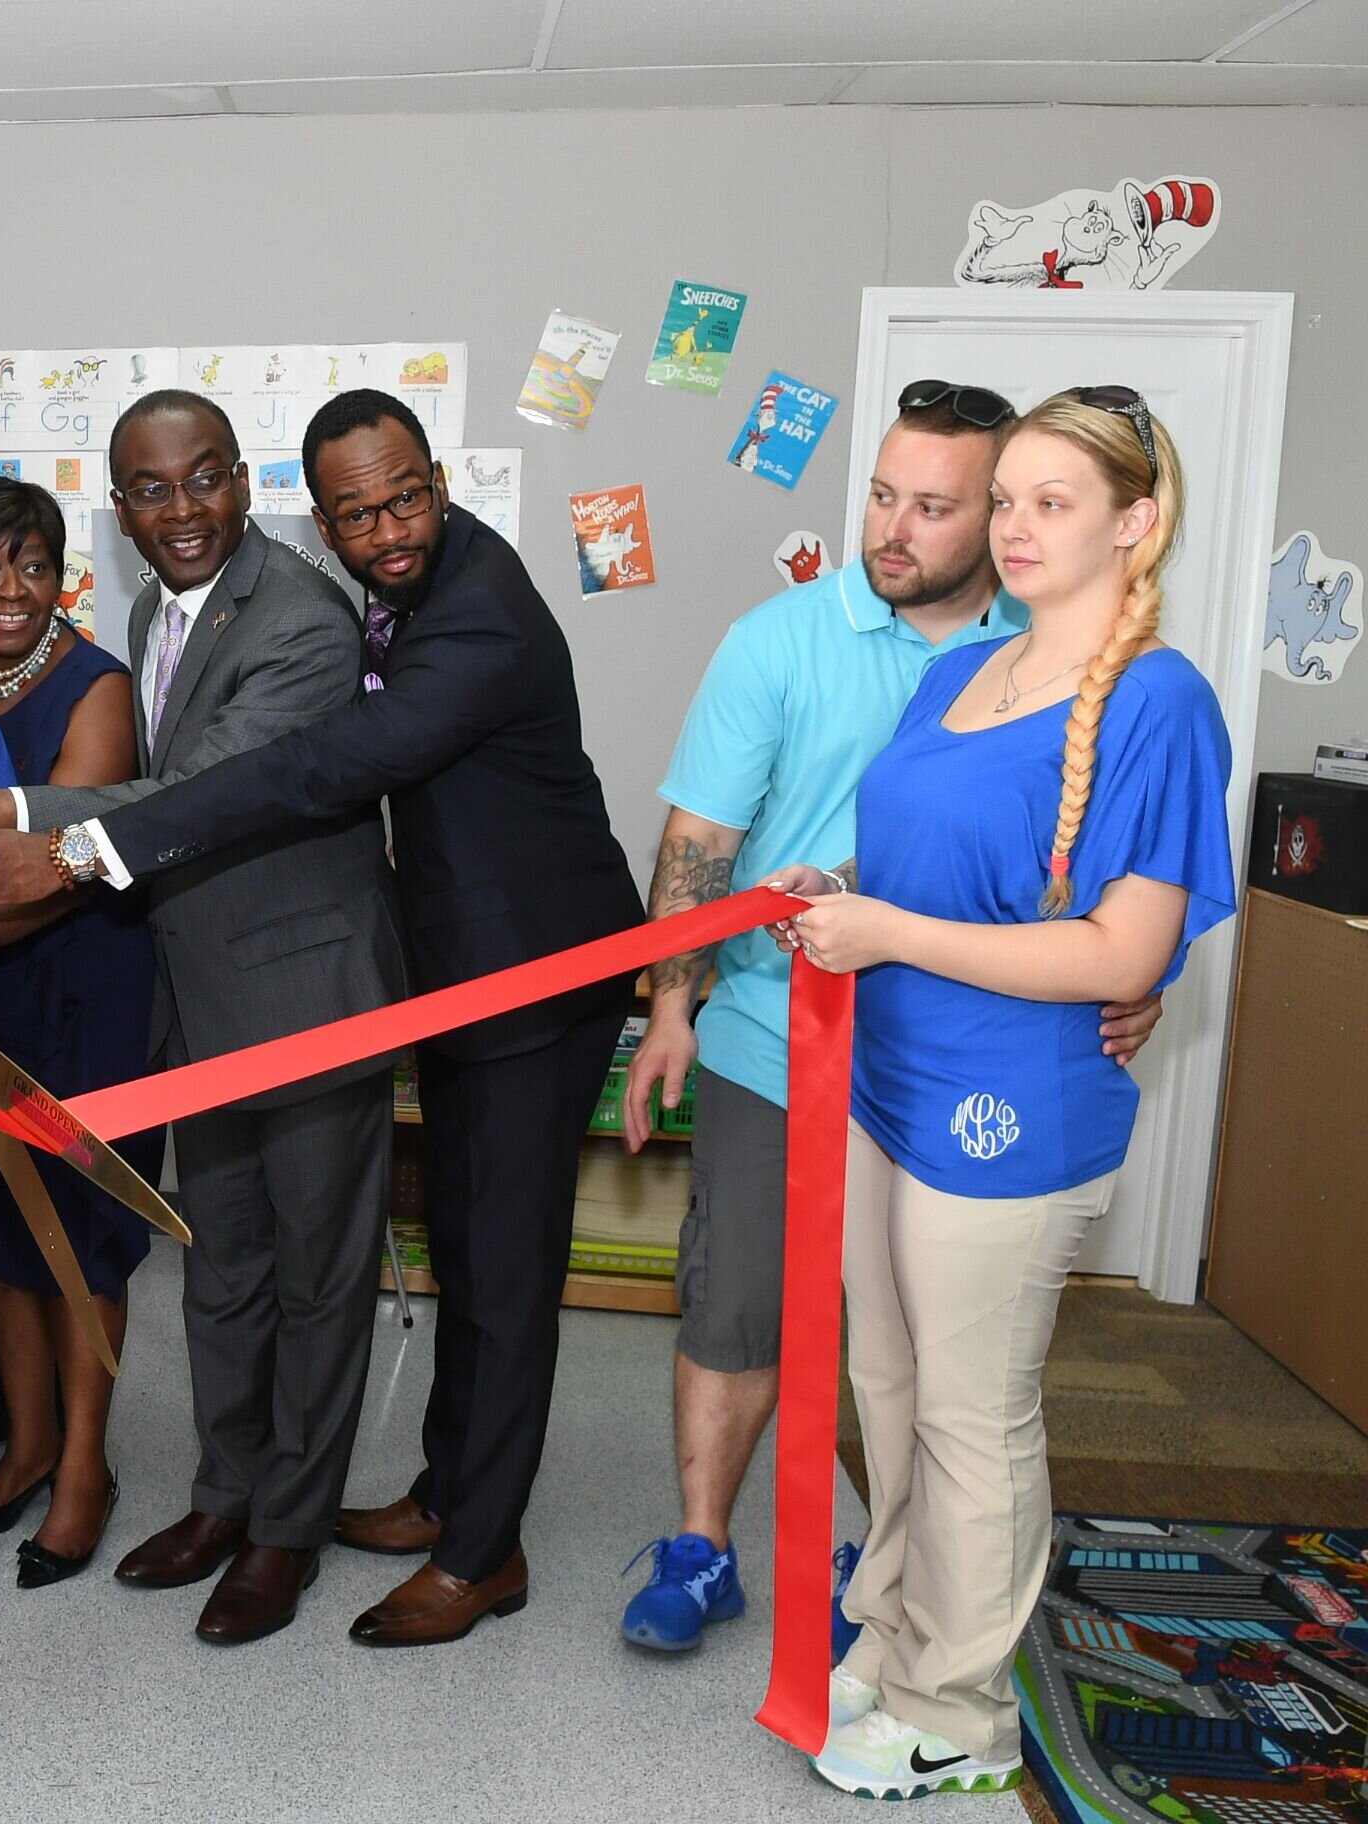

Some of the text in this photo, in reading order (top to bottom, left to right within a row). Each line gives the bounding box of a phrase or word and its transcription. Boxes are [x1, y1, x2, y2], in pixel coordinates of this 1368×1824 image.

[680, 287, 741, 311] SNEETCHES
[686, 366, 720, 388] Seuss
[777, 380, 832, 411] THE CAT
[41, 402, 89, 446] Gg
[257, 399, 287, 443] Jj
[794, 413, 812, 426] THE
[801, 406, 815, 417] IN
[778, 419, 816, 443] HAT
[572, 494, 610, 521] HORTON
[591, 499, 619, 525] HEARS
[613, 493, 640, 520] WHO!
[64, 563, 82, 577] Fox
[13, 1075, 49, 1111] GRAND
[51, 1105, 95, 1152] OPENING
